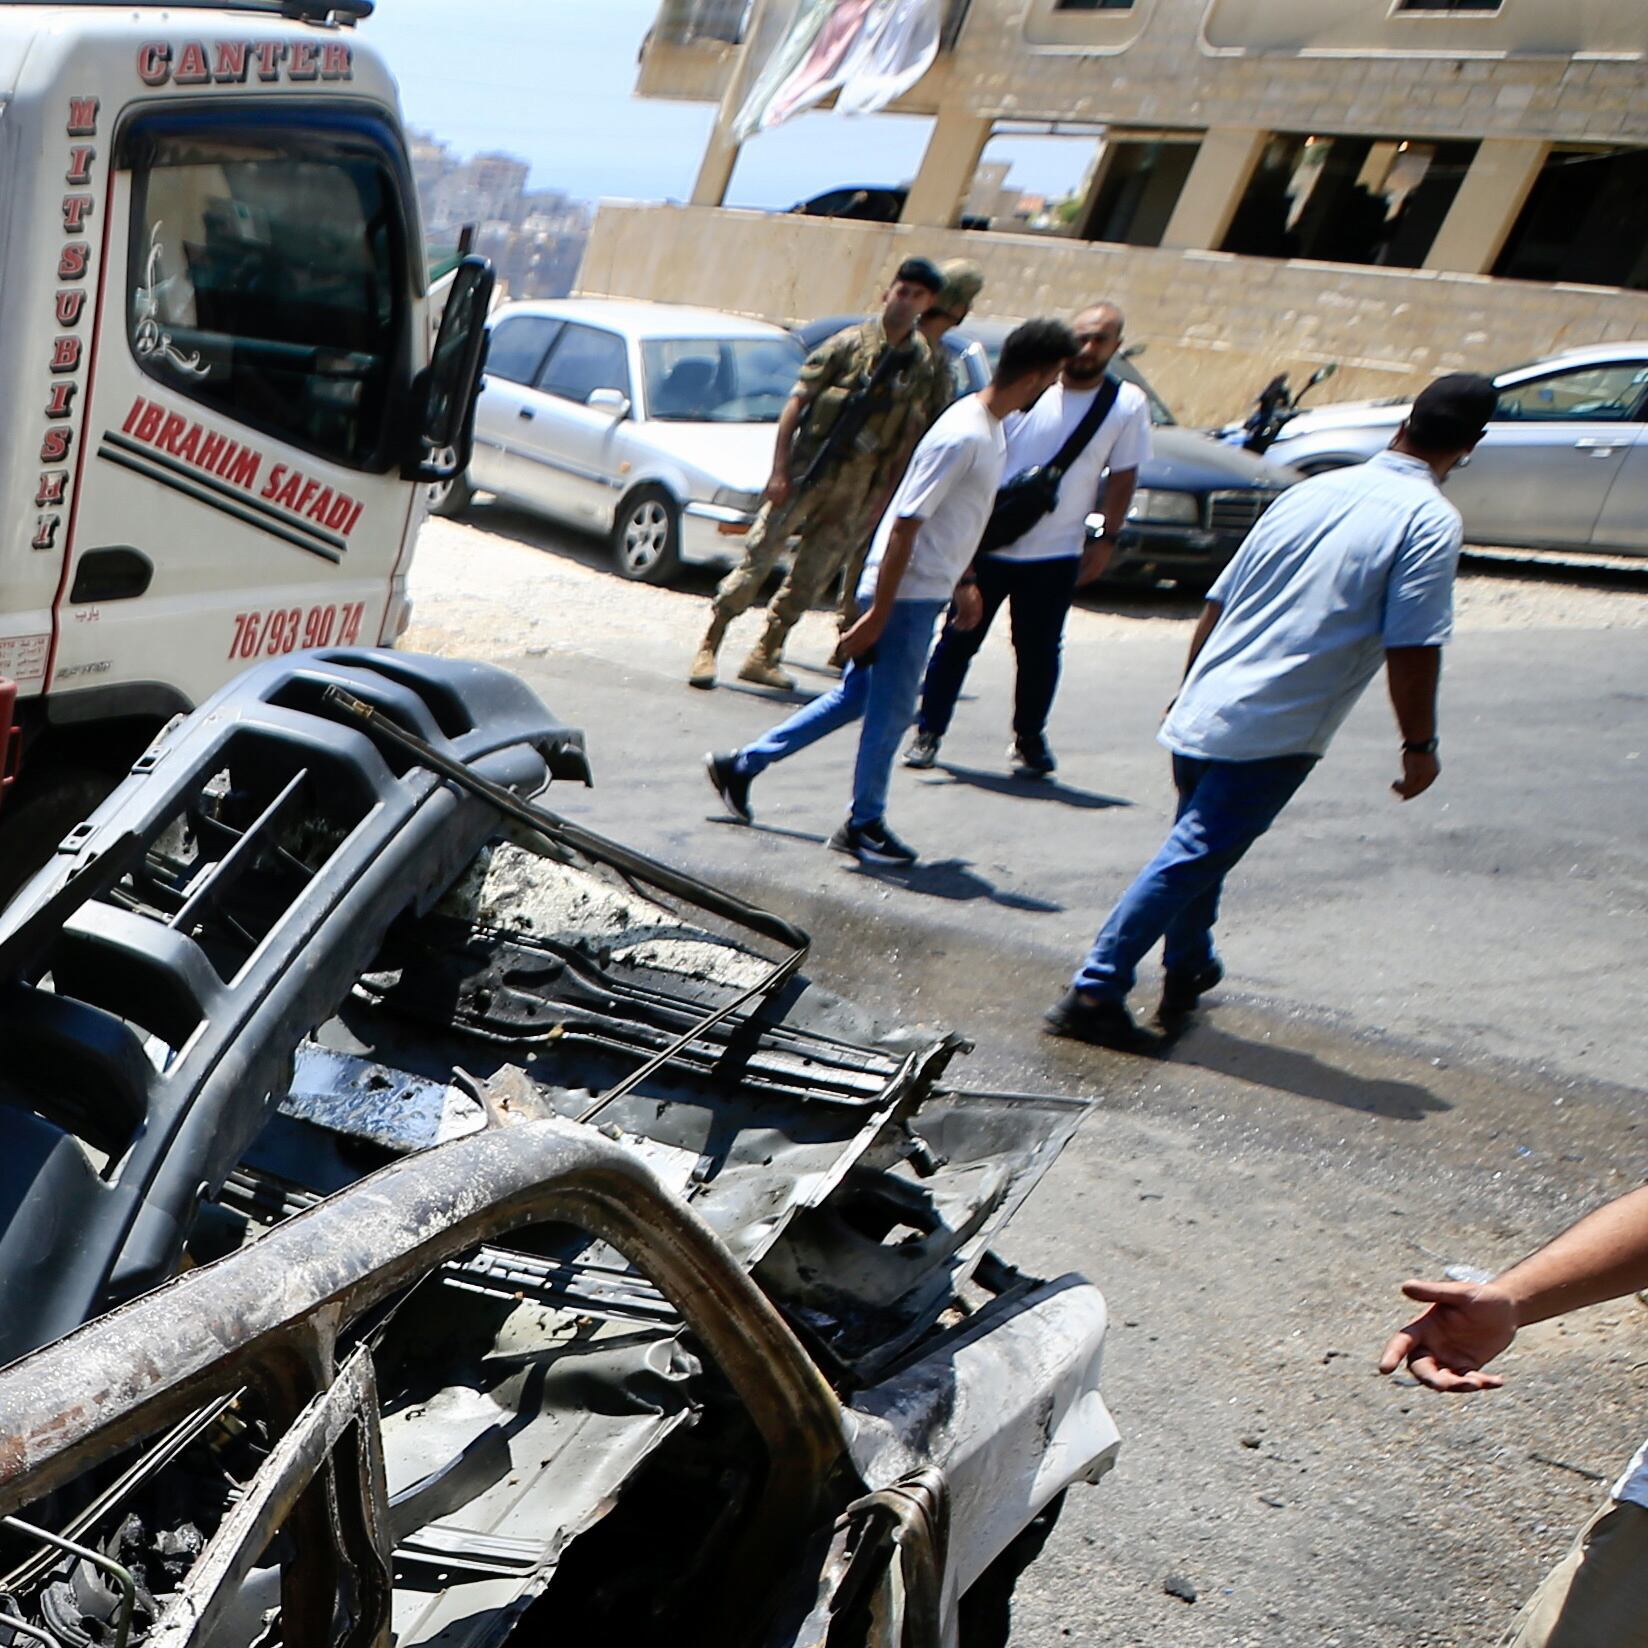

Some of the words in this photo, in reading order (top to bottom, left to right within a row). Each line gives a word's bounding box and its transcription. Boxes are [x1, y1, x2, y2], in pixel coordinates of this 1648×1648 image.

[136, 40, 353, 87] CANTER
[31, 96, 100, 550] MITSUBISHI
[121, 394, 264, 490] IBRAHIM
[260, 461, 365, 537] SAFADI
[228, 607, 302, 659] 76/93
[302, 603, 337, 649] 90
[335, 601, 365, 646] 74
